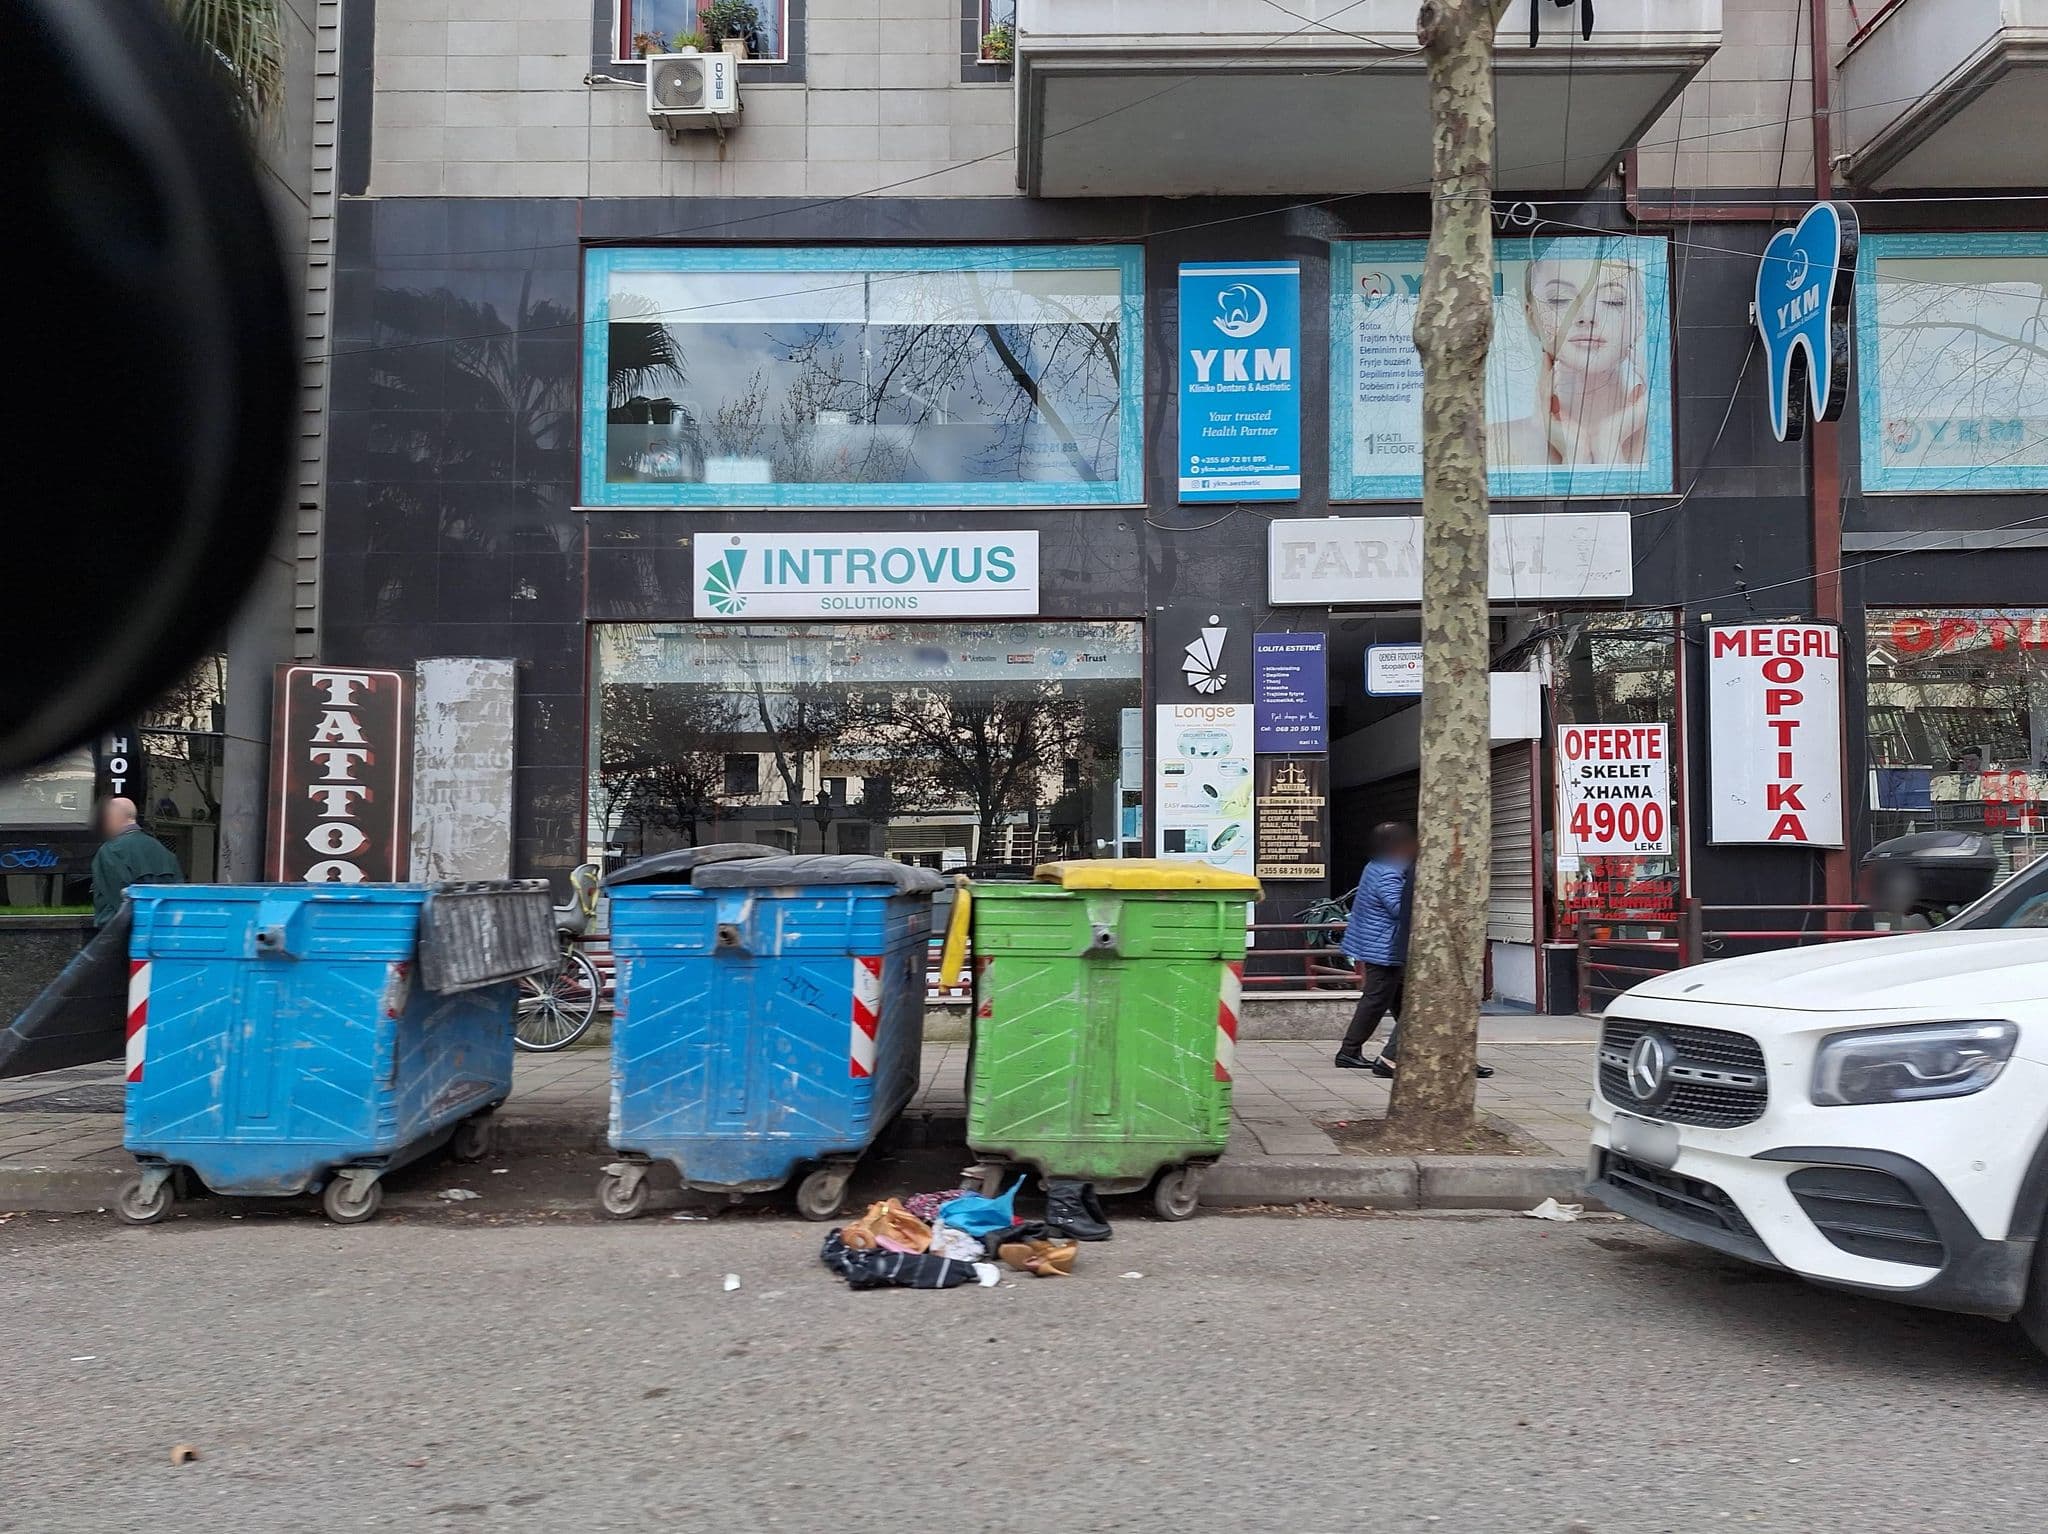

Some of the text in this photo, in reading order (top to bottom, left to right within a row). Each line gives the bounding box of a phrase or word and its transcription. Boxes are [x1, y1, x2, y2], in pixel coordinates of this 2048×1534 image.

[715, 62, 724, 100] BEKO
[1777, 283, 1820, 330] YKM
[1360, 322, 1381, 331] Botox
[1360, 334, 1388, 344] Trajtim
[1360, 346, 1397, 354] Eleminim
[1189, 348, 1292, 382] YKM
[1360, 358, 1382, 368] Fryrje
[1408, 370, 1424, 379] lase
[1189, 382, 1291, 393] Klinike Dentare & Aesthetic
[1401, 382, 1425, 392] përhe
[1360, 394, 1412, 404] Microblading
[1209, 409, 1272, 422] Your trusted
[1202, 426, 1279, 438] Health Partner
[1364, 433, 1402, 455] 1 KATI
[1377, 445, 1415, 455] FLOOR
[764, 545, 1016, 585] INTROVUS
[821, 596, 919, 610] SOLUTIONS
[1714, 629, 1840, 659] MEGAL
[1083, 653, 1107, 662] Trust
[1175, 706, 1236, 722] Longse
[1565, 729, 1662, 760] OFERTE
[1762, 657, 1808, 841] OPTIKA
[303, 673, 370, 882] TATTOO
[1581, 765, 1651, 778] SKELET
[1583, 785, 1653, 799] XHAMA
[1570, 802, 1664, 843] 4900
[1634, 843, 1663, 851] LEKE
